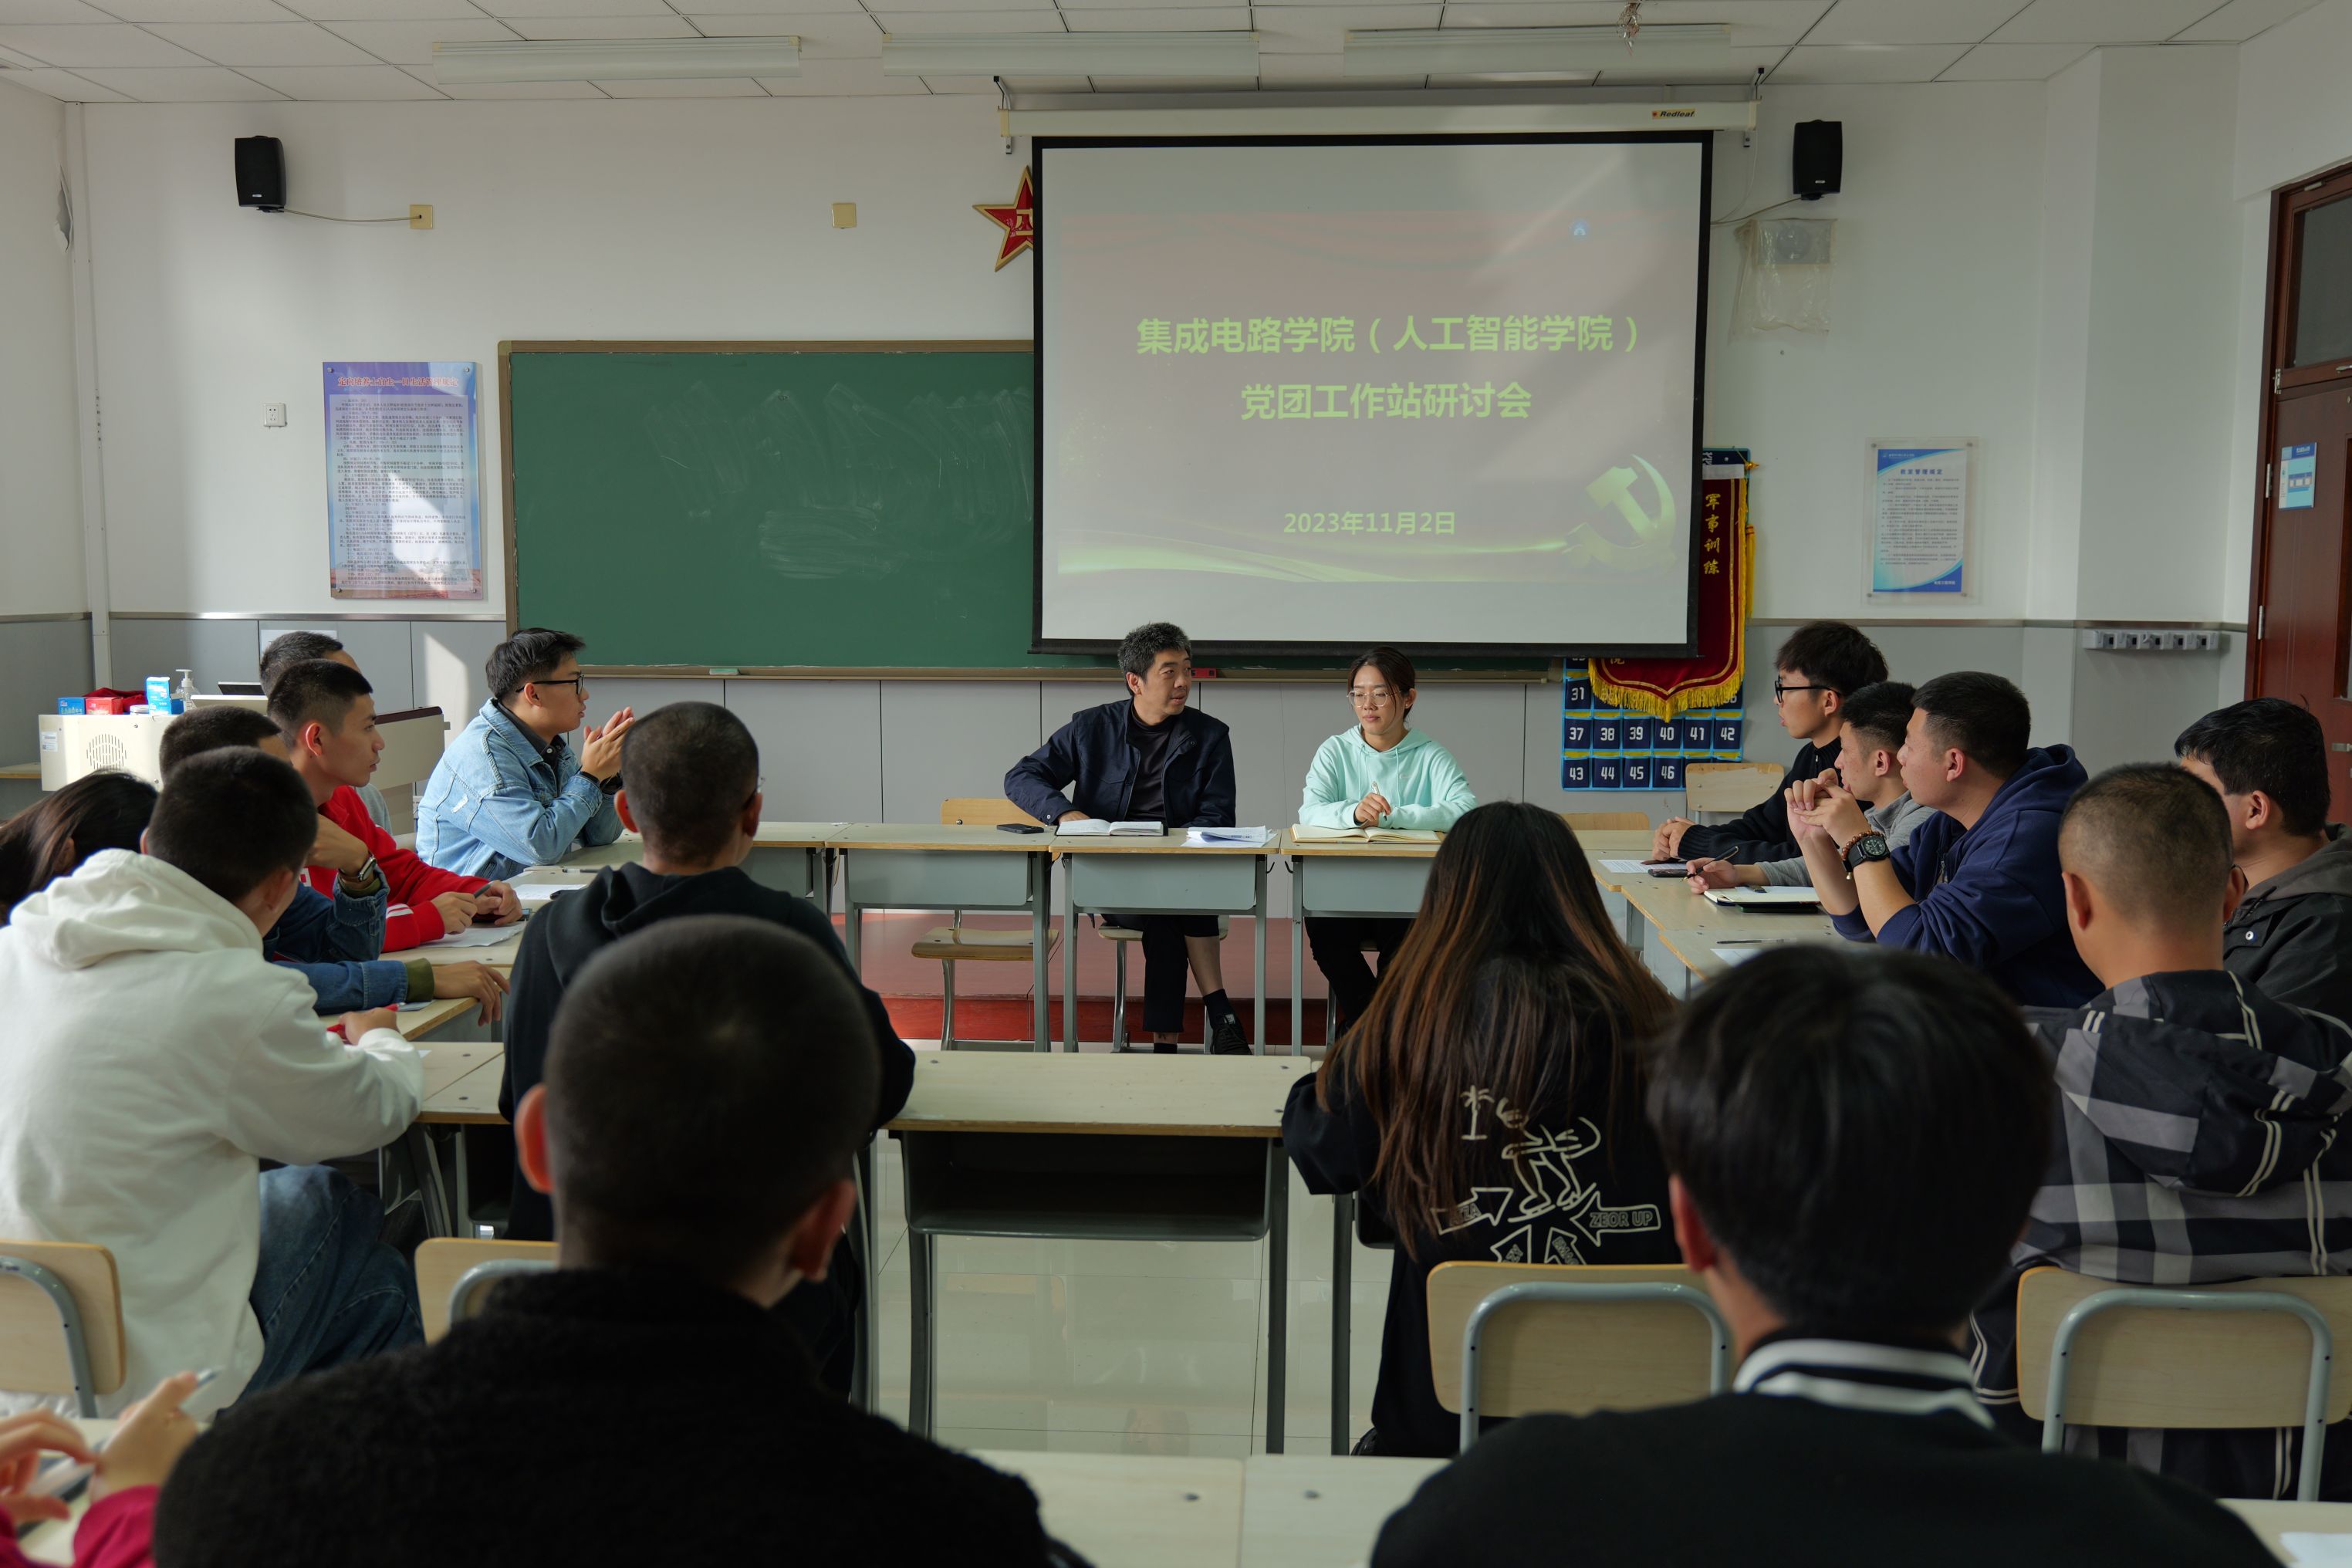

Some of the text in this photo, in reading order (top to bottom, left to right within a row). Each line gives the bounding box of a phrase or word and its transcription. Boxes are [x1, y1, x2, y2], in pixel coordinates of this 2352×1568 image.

[1136, 314, 1638, 355] 集成电路学院（人工智能学院）
[1241, 382, 1532, 421] 党团工作站研讨会
[1283, 512, 1455, 535] 2023年11月2日
[1703, 493, 1721, 575] 军事训练
[1571, 687, 1585, 701] 31
[1569, 726, 1735, 741] 37 38 39 40 41 42
[1570, 765, 1674, 780] 43 44 45 46
[1590, 1211, 1654, 1228] ZEOR UP
